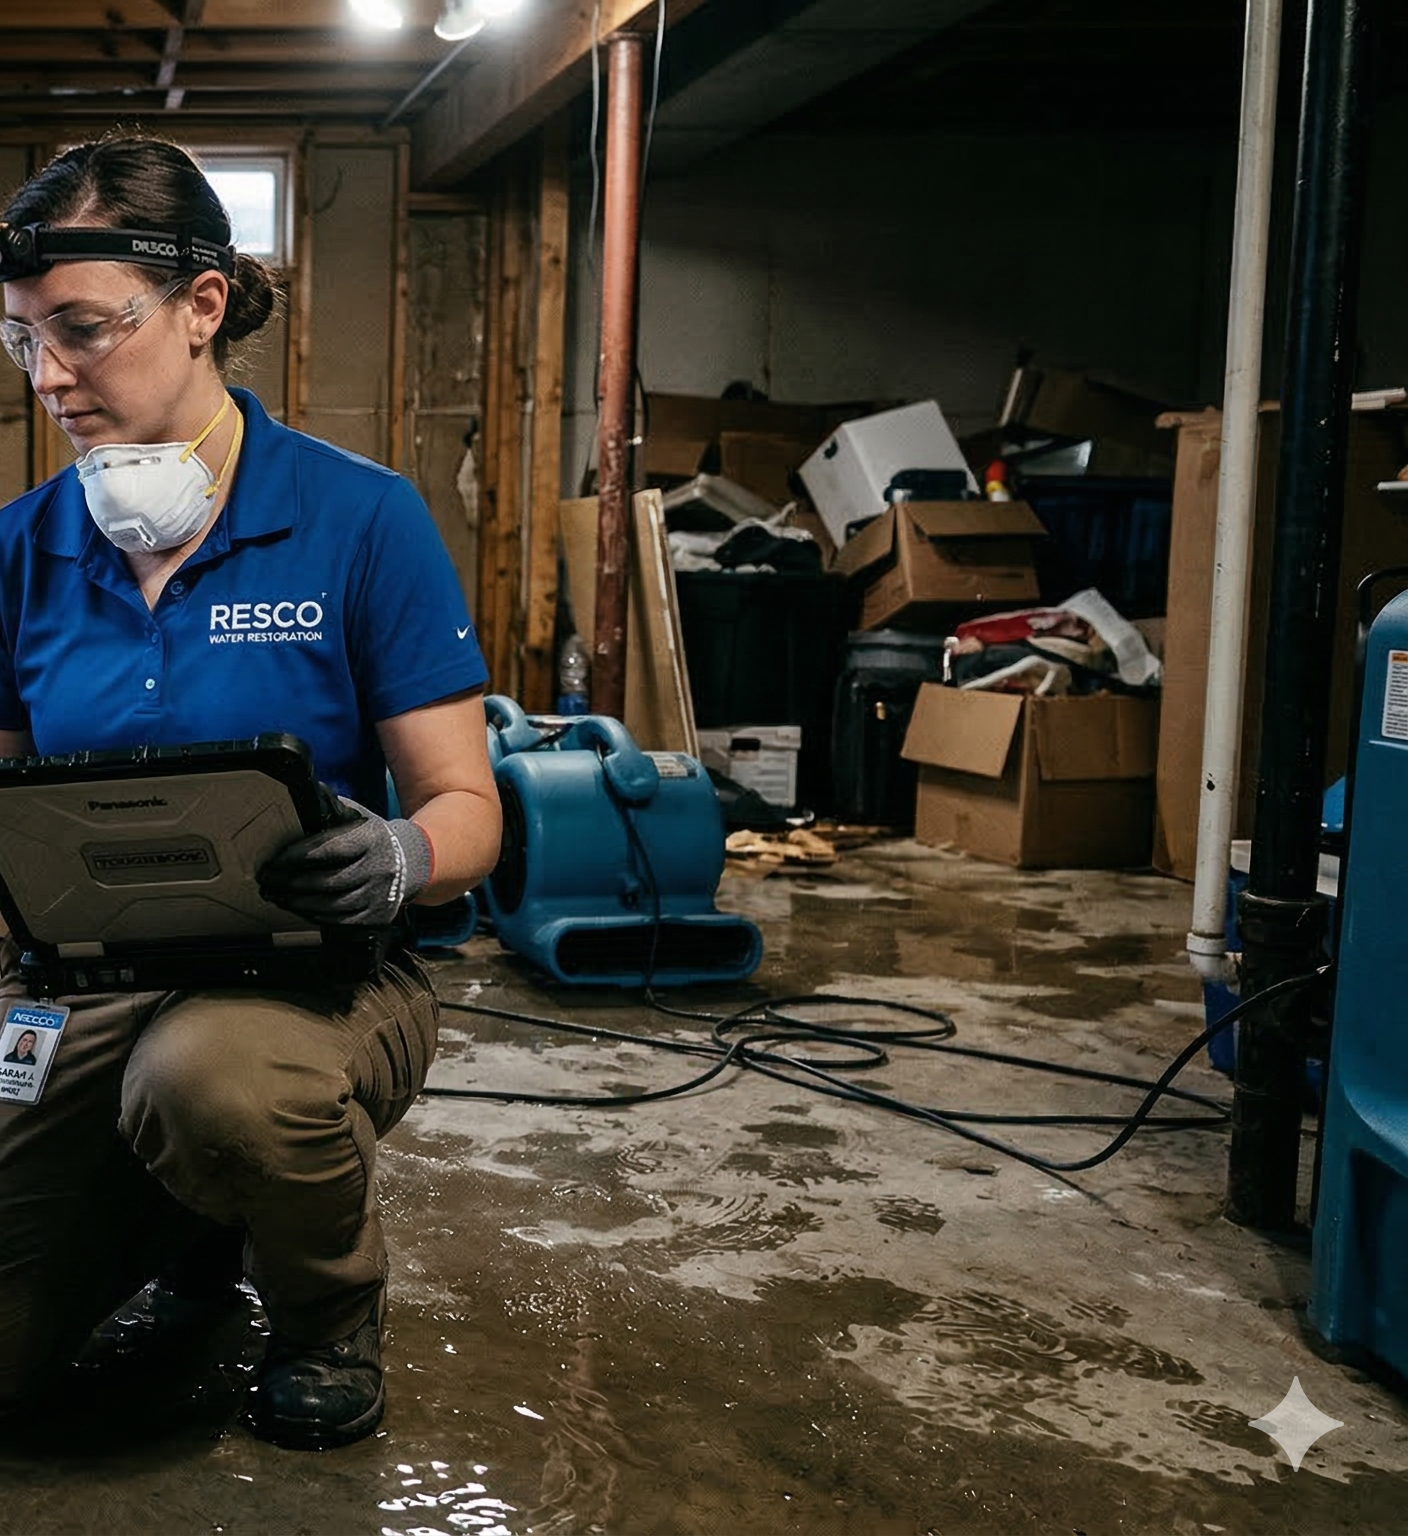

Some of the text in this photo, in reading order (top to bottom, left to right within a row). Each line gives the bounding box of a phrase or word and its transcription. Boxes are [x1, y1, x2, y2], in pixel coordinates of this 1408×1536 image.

[209, 601, 324, 630] RESCO
[209, 630, 323, 644] WATER RESTORATION
[88, 795, 168, 811] Panasonic
